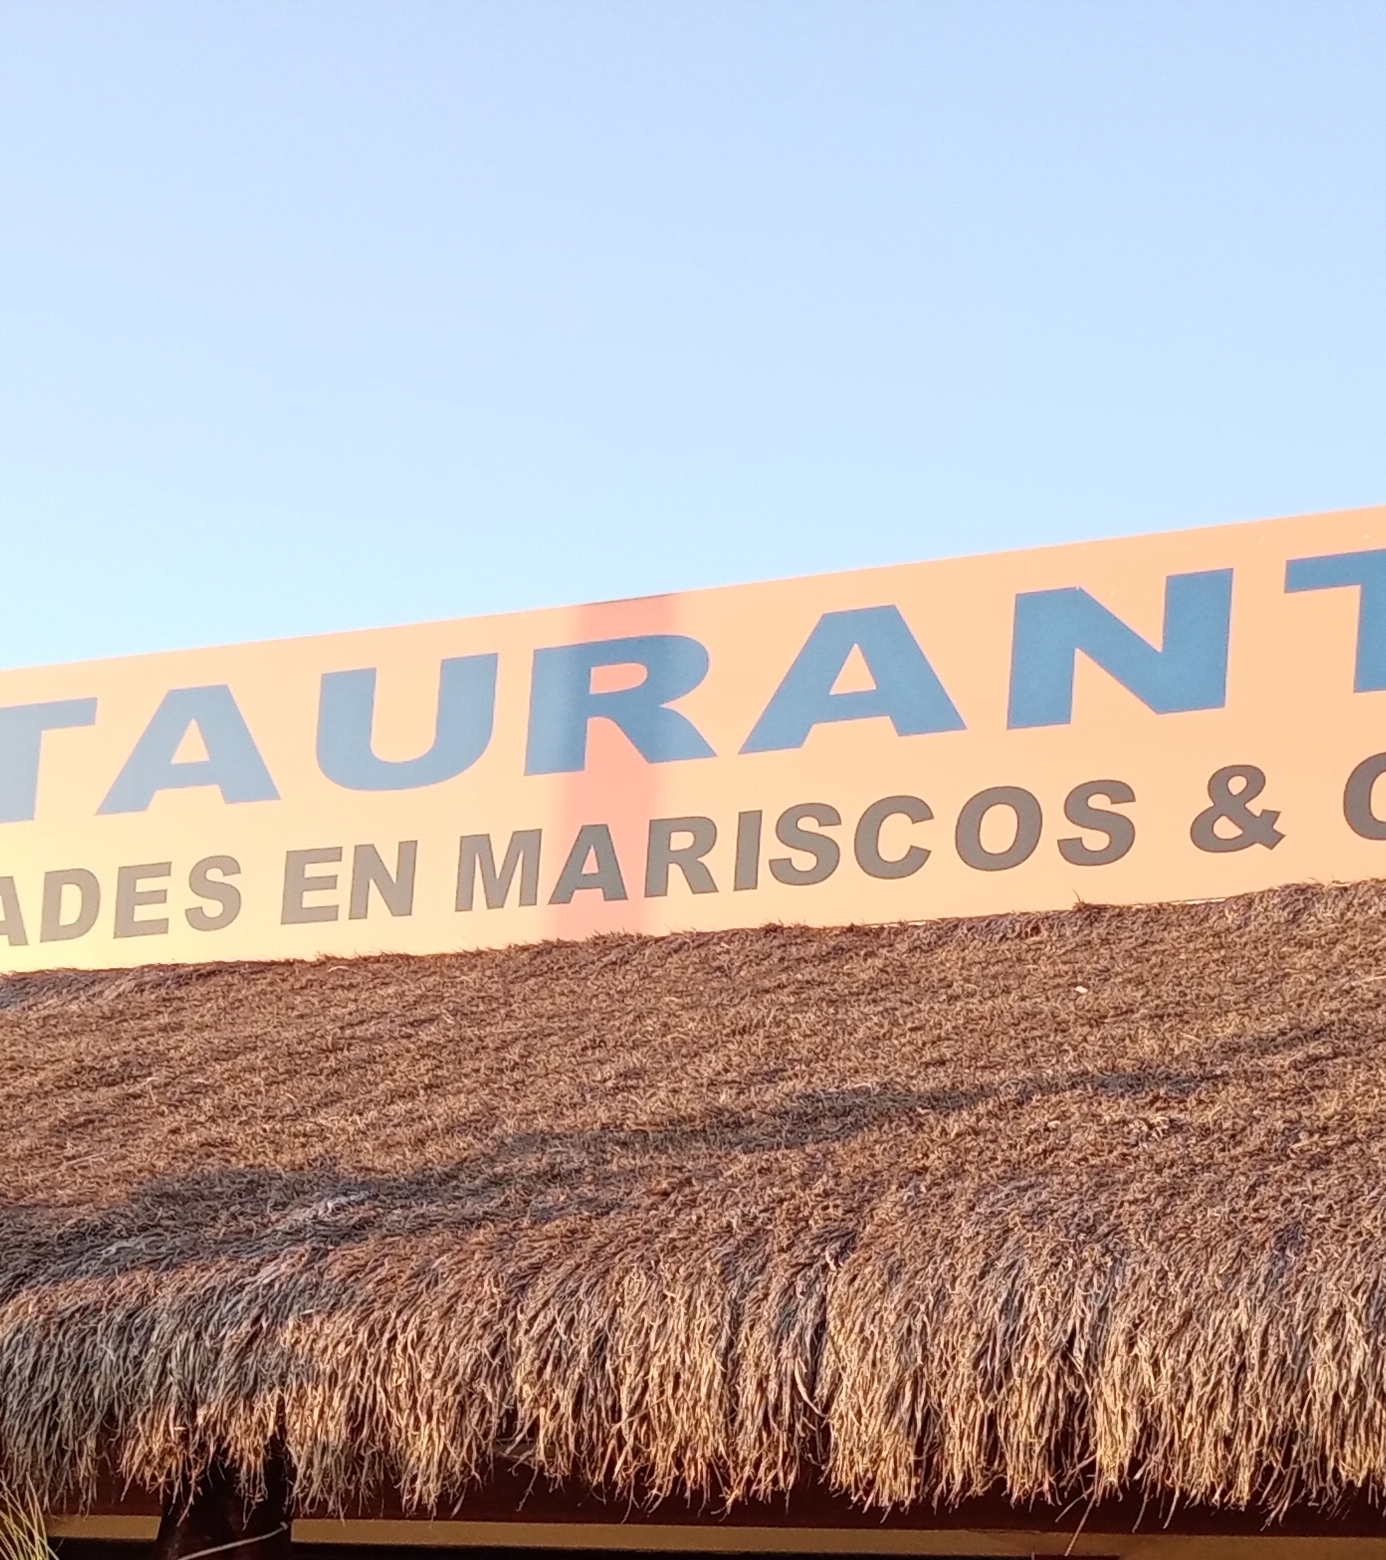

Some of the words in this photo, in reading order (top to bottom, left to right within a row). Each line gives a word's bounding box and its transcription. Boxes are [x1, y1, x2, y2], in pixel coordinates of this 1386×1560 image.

[280, 840, 418, 925] EN
[454, 779, 1137, 913] MARISCOS
[1189, 764, 1286, 852] &
